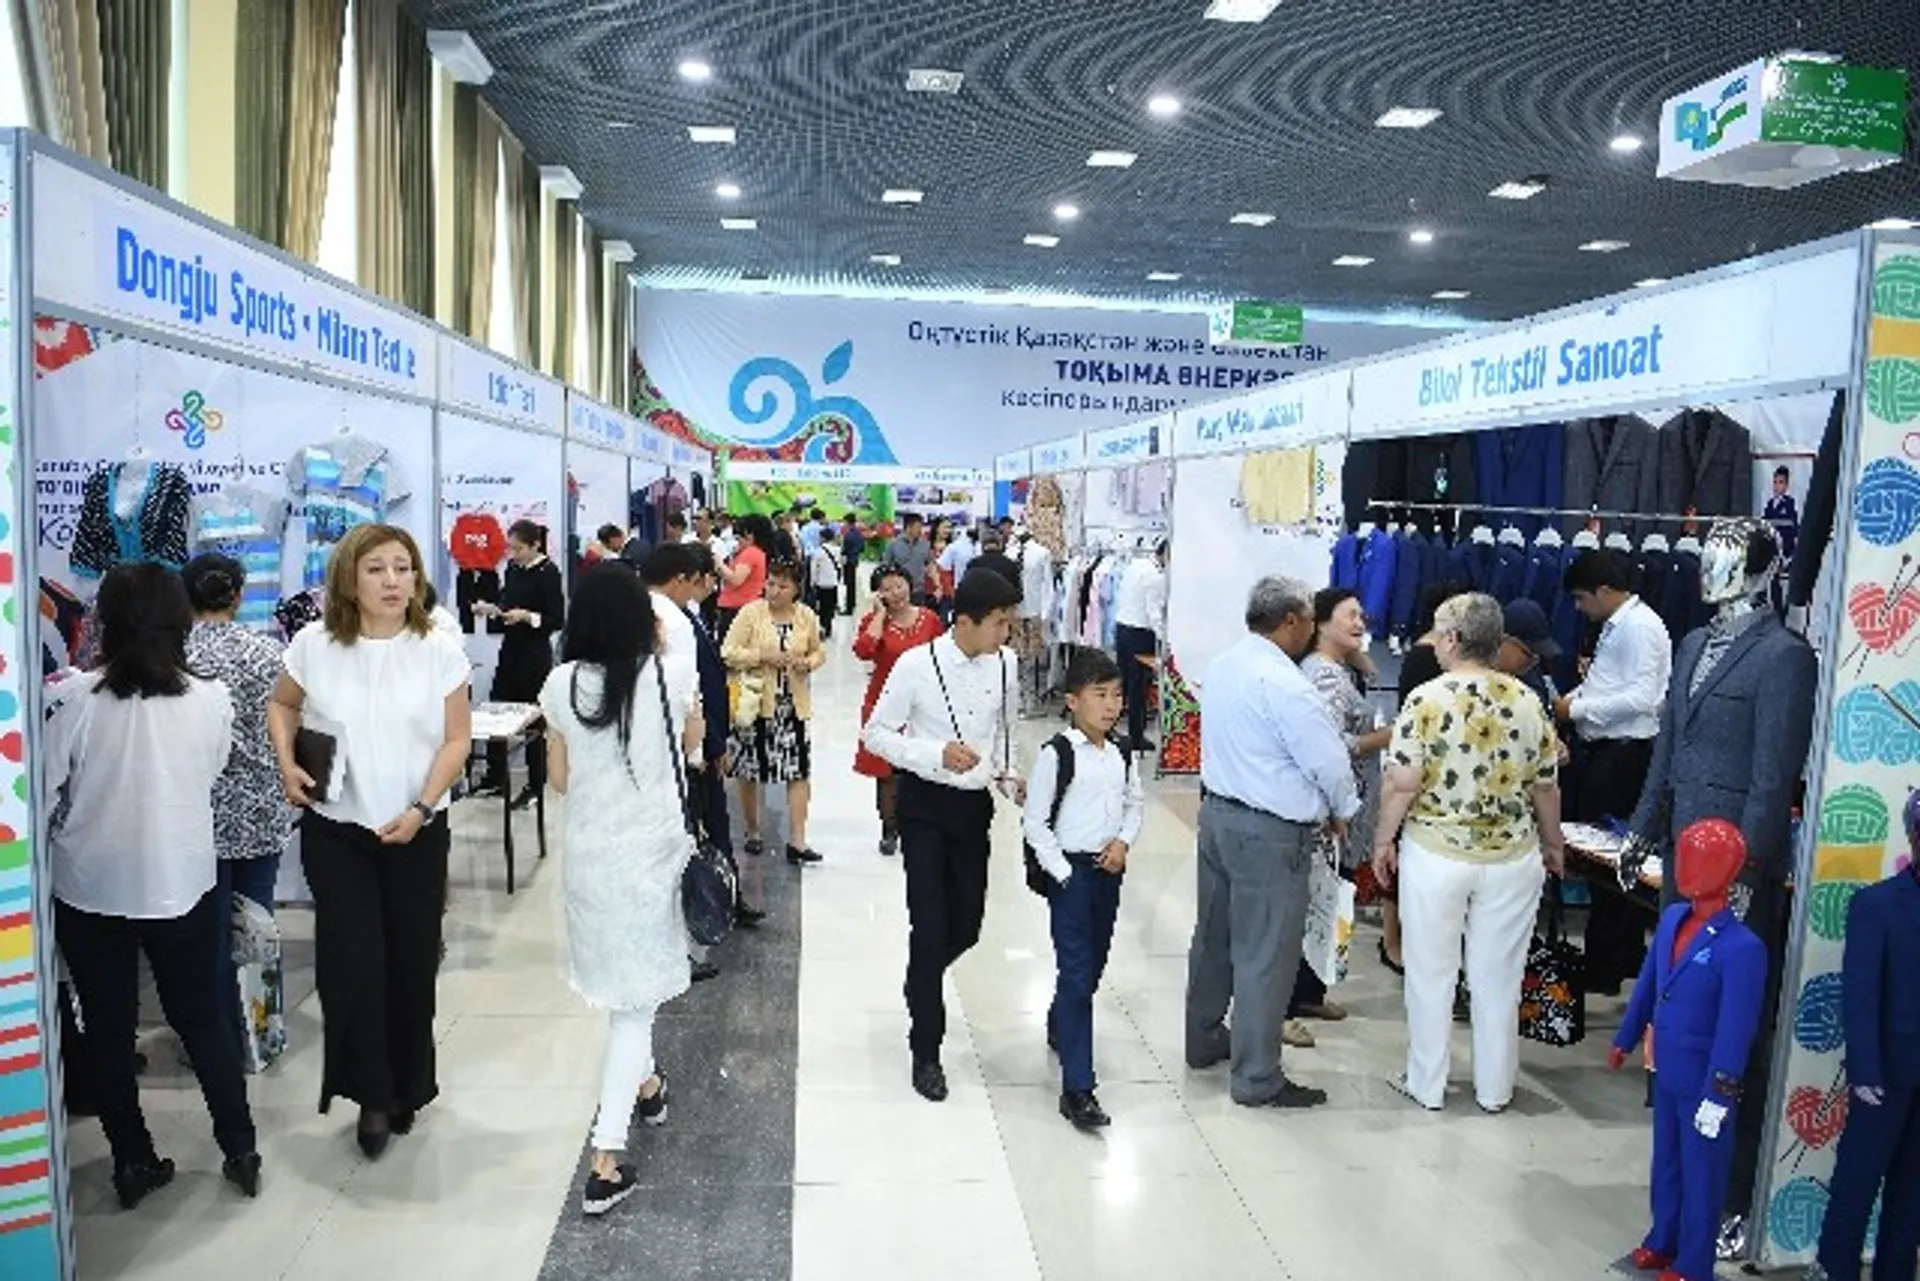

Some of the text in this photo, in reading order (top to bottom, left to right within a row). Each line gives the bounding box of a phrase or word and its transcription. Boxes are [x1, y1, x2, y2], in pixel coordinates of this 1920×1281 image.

[116, 225, 218, 324] Dongju
[229, 269, 297, 341] Sports
[1016, 325, 1139, 352] Қазақстан
[1556, 324, 1664, 388] Sanoat
[1054, 359, 1171, 386] ТОҚЫМА
